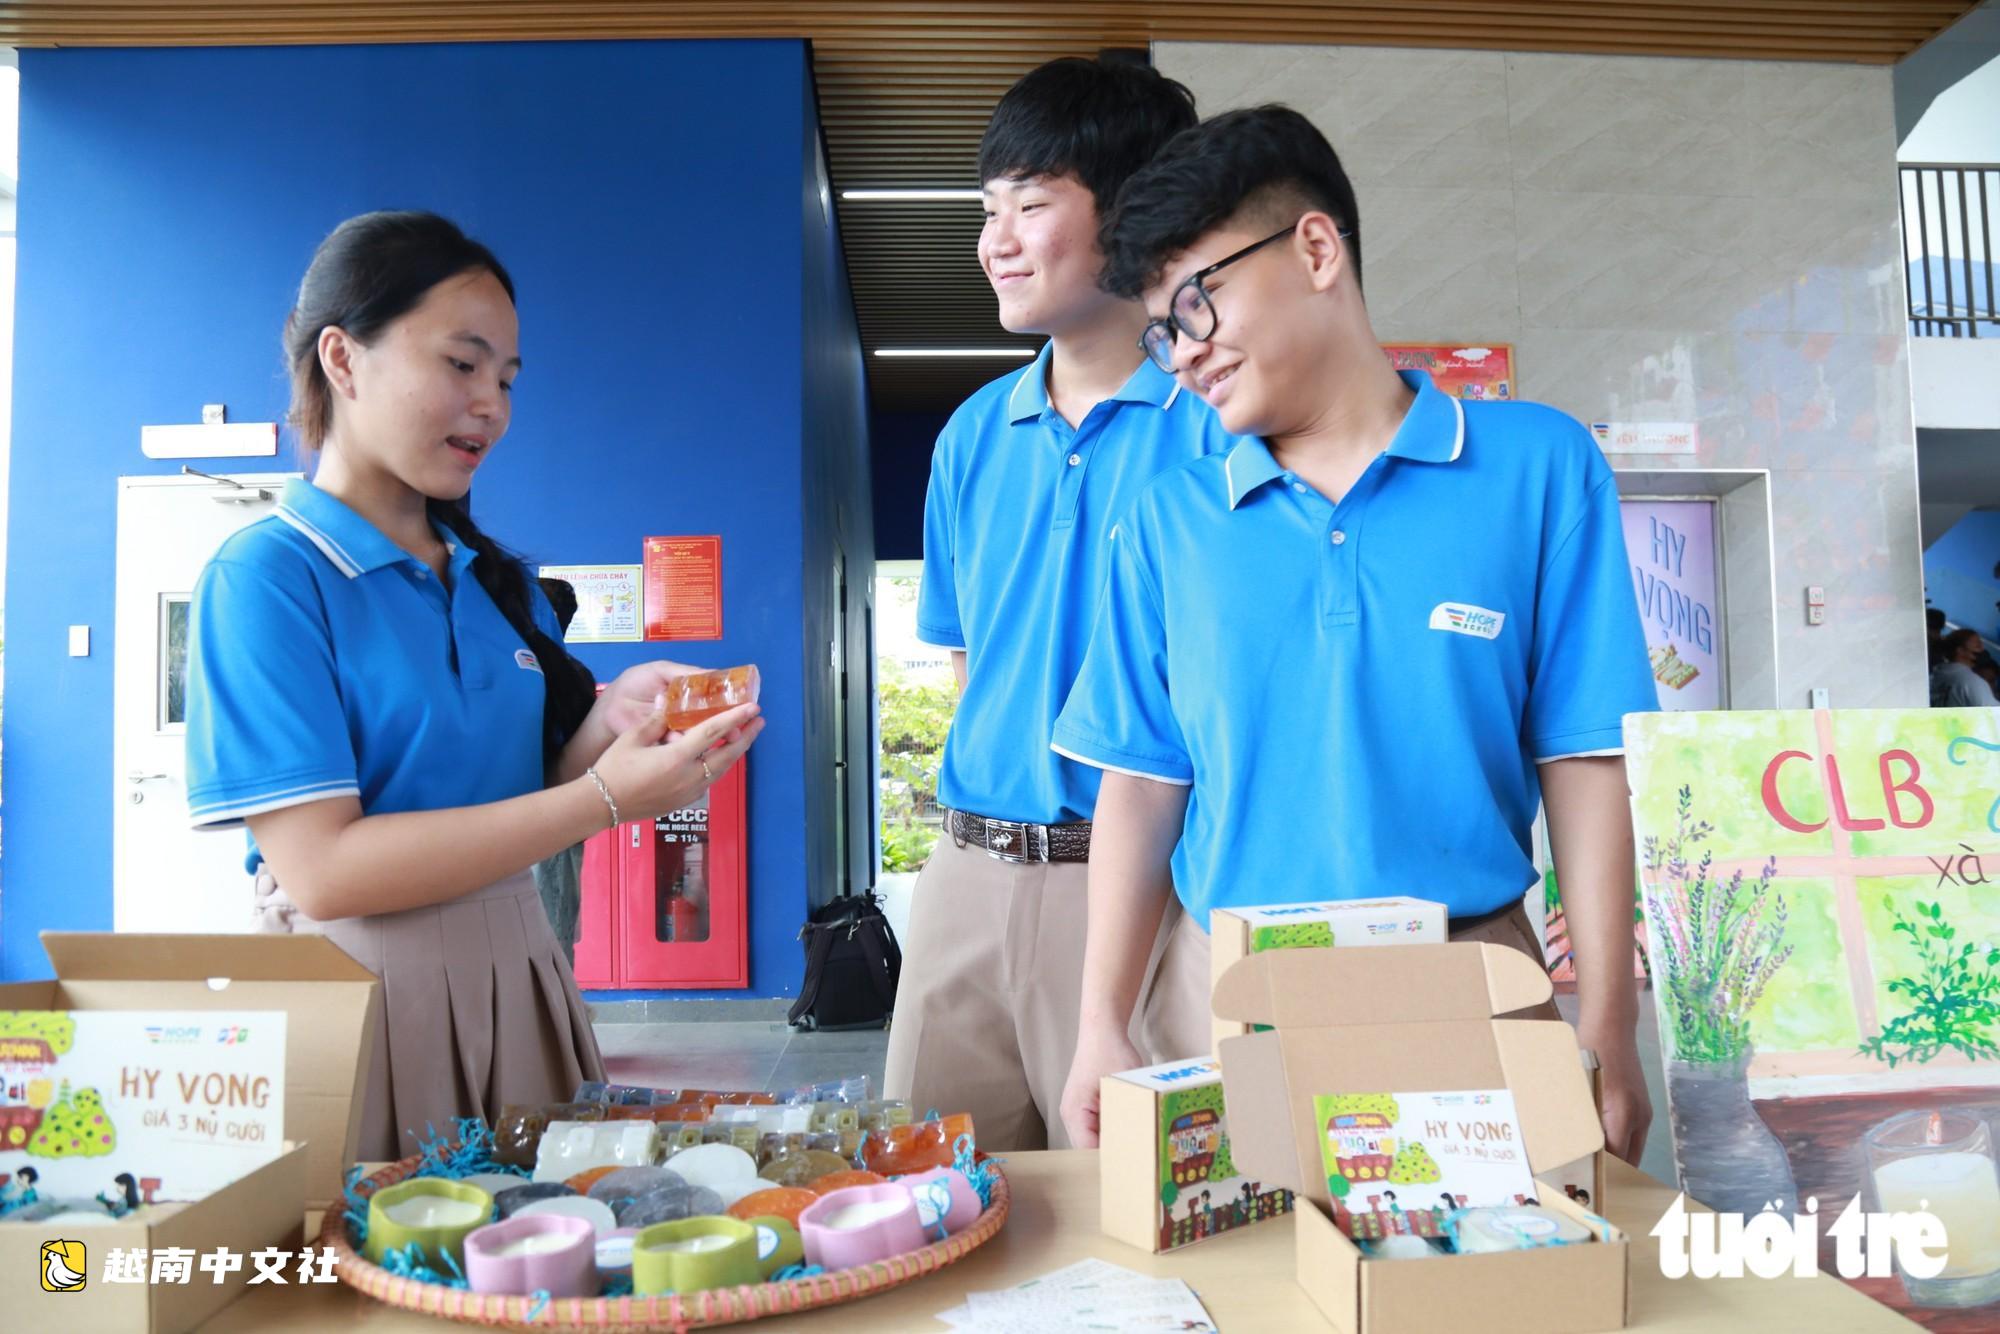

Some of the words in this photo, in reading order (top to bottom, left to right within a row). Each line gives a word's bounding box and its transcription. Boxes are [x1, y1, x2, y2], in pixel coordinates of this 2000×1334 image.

[1650, 516, 1686, 578] HY
[1636, 566, 1712, 655] VỌNG
[1760, 749, 1935, 833] CLB
[655, 823, 670, 831] FIRE
[690, 824, 708, 832] REEL
[680, 834, 698, 843] 114
[1927, 842, 1992, 889] xà
[120, 1066, 161, 1100] HY
[177, 1072, 271, 1115] VỌNG
[143, 1107, 170, 1127] GIÁ
[178, 1114, 188, 1130] 3
[196, 1116, 218, 1140] NỤ
[1425, 1120, 1448, 1139] HY
[1457, 1121, 1512, 1146] VỌNG
